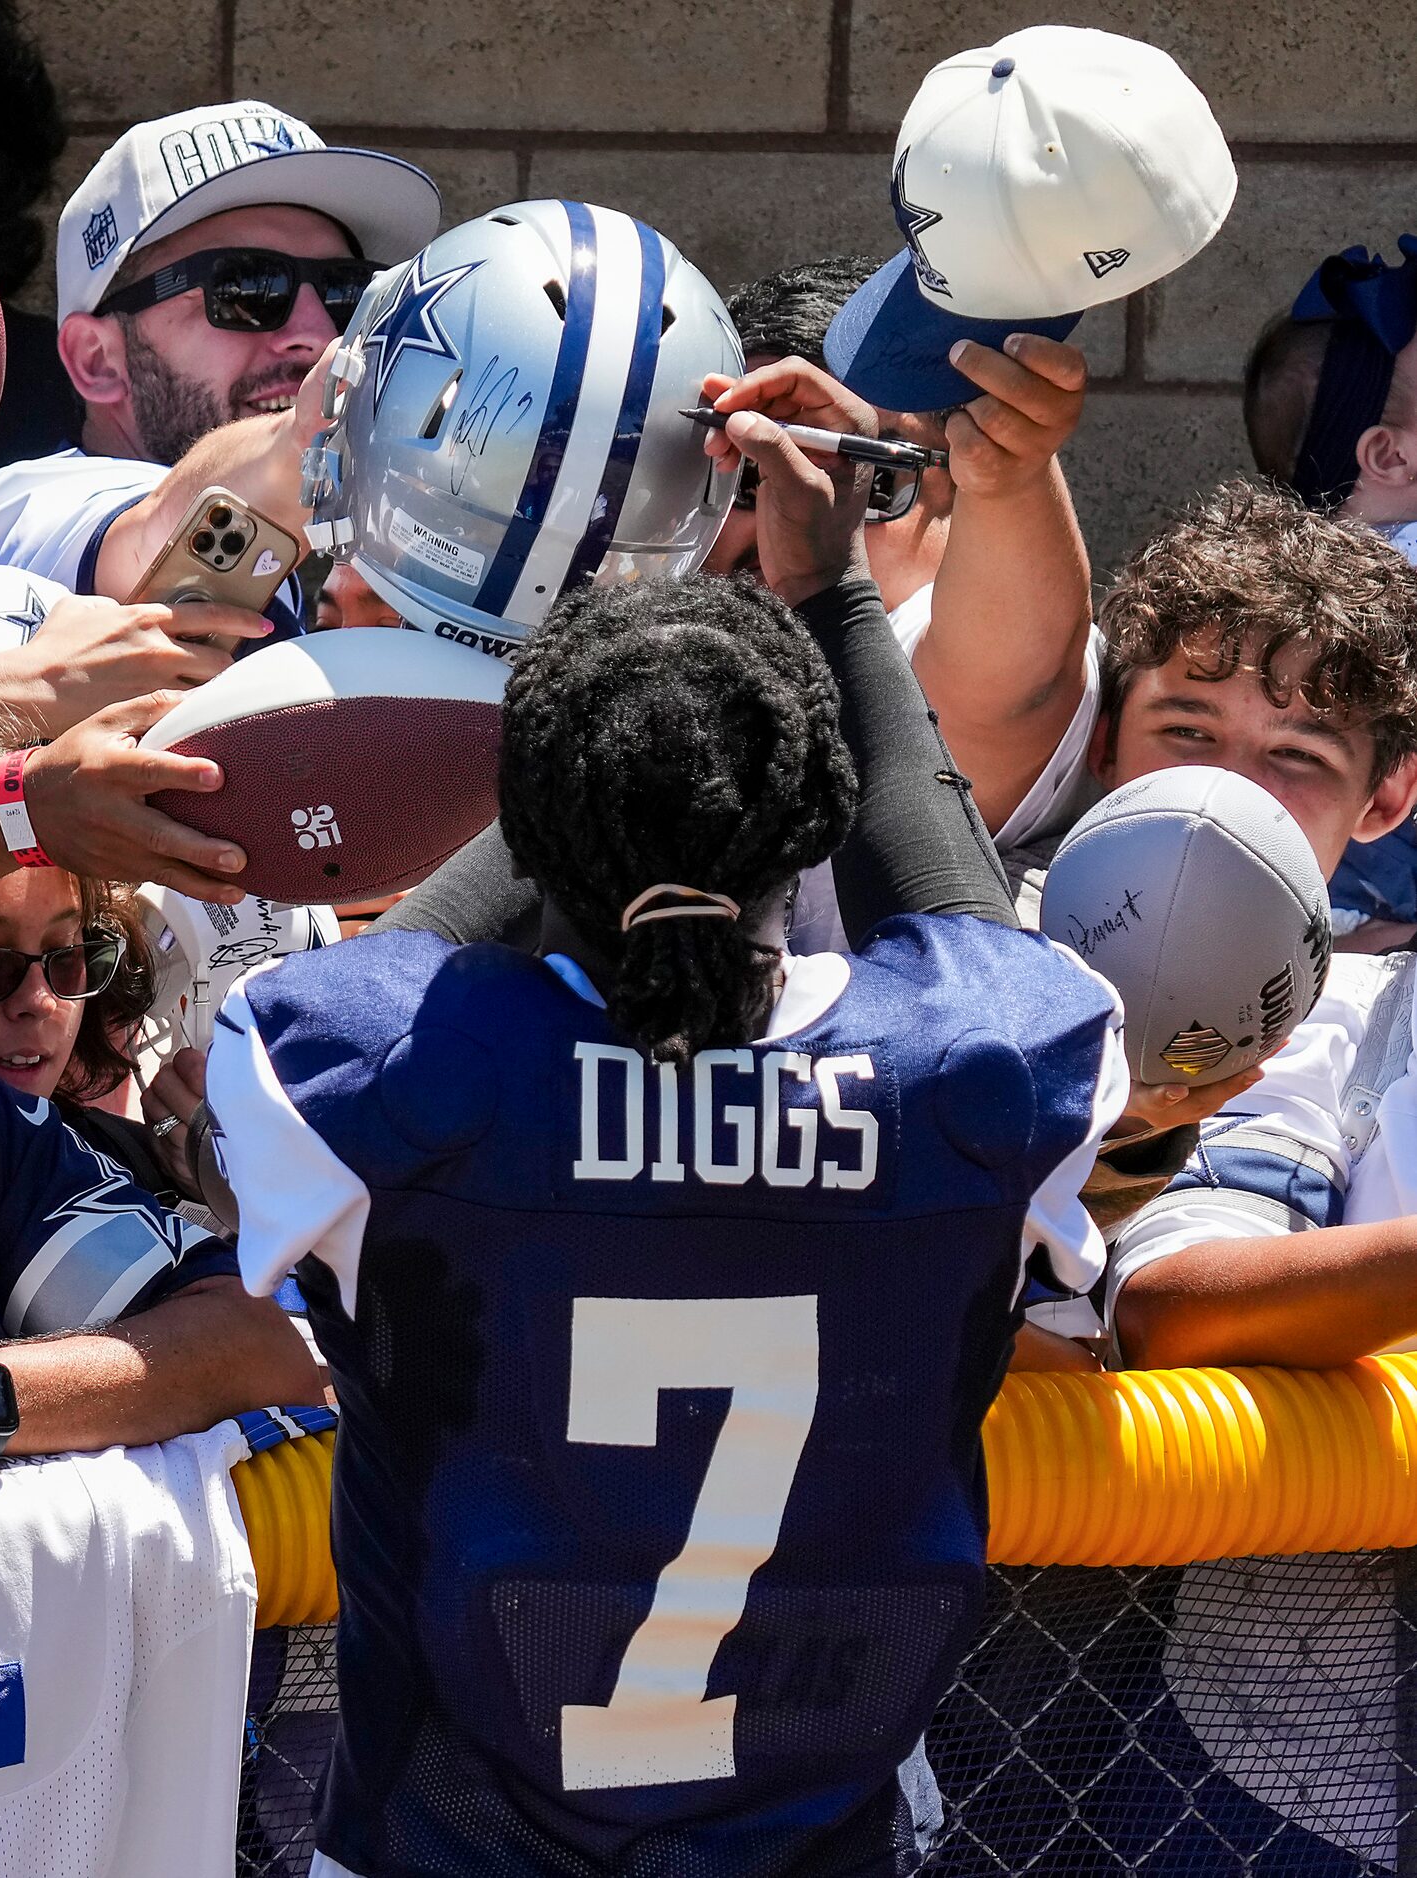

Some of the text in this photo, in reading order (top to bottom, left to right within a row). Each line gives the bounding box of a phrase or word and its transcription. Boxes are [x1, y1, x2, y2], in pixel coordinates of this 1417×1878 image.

[413, 523, 459, 557] WARNING
[572, 1041, 879, 1191] DIGGS
[561, 1294, 819, 1791] 7
